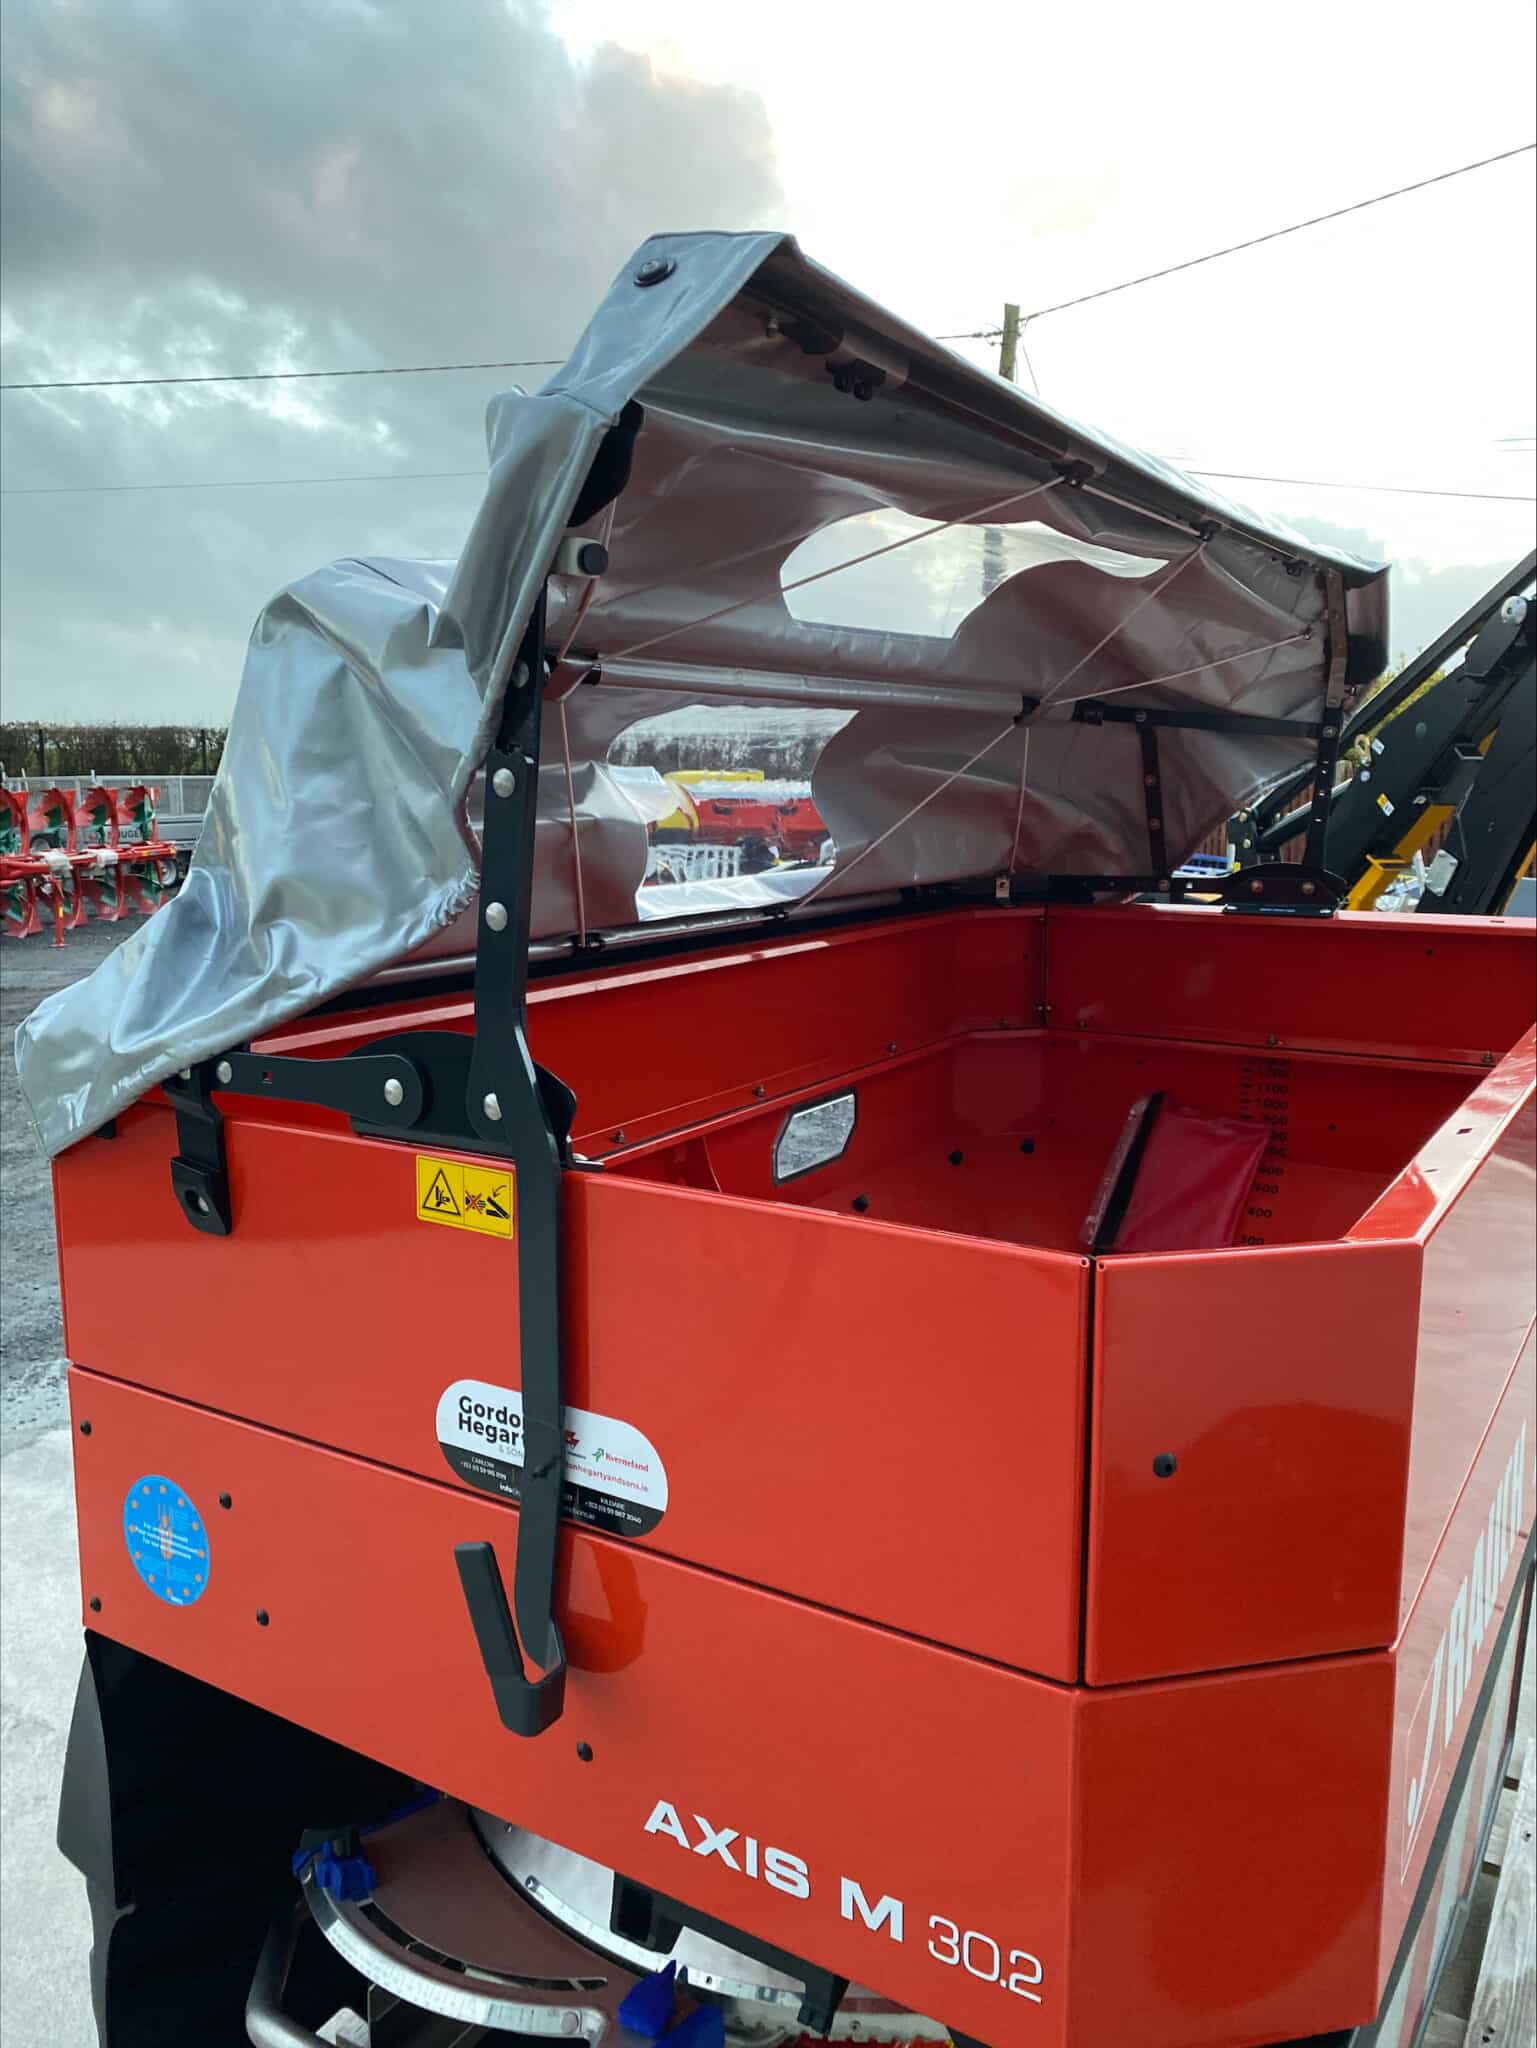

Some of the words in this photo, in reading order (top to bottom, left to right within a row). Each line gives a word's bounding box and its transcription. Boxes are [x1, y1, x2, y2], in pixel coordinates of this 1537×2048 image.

[458, 1395, 522, 1428] Gordo
[458, 1412, 520, 1446] Hegar
[644, 1799, 811, 1899] AXIS
[840, 1876, 904, 1943] M
[928, 1914, 1043, 2004] 30.2
